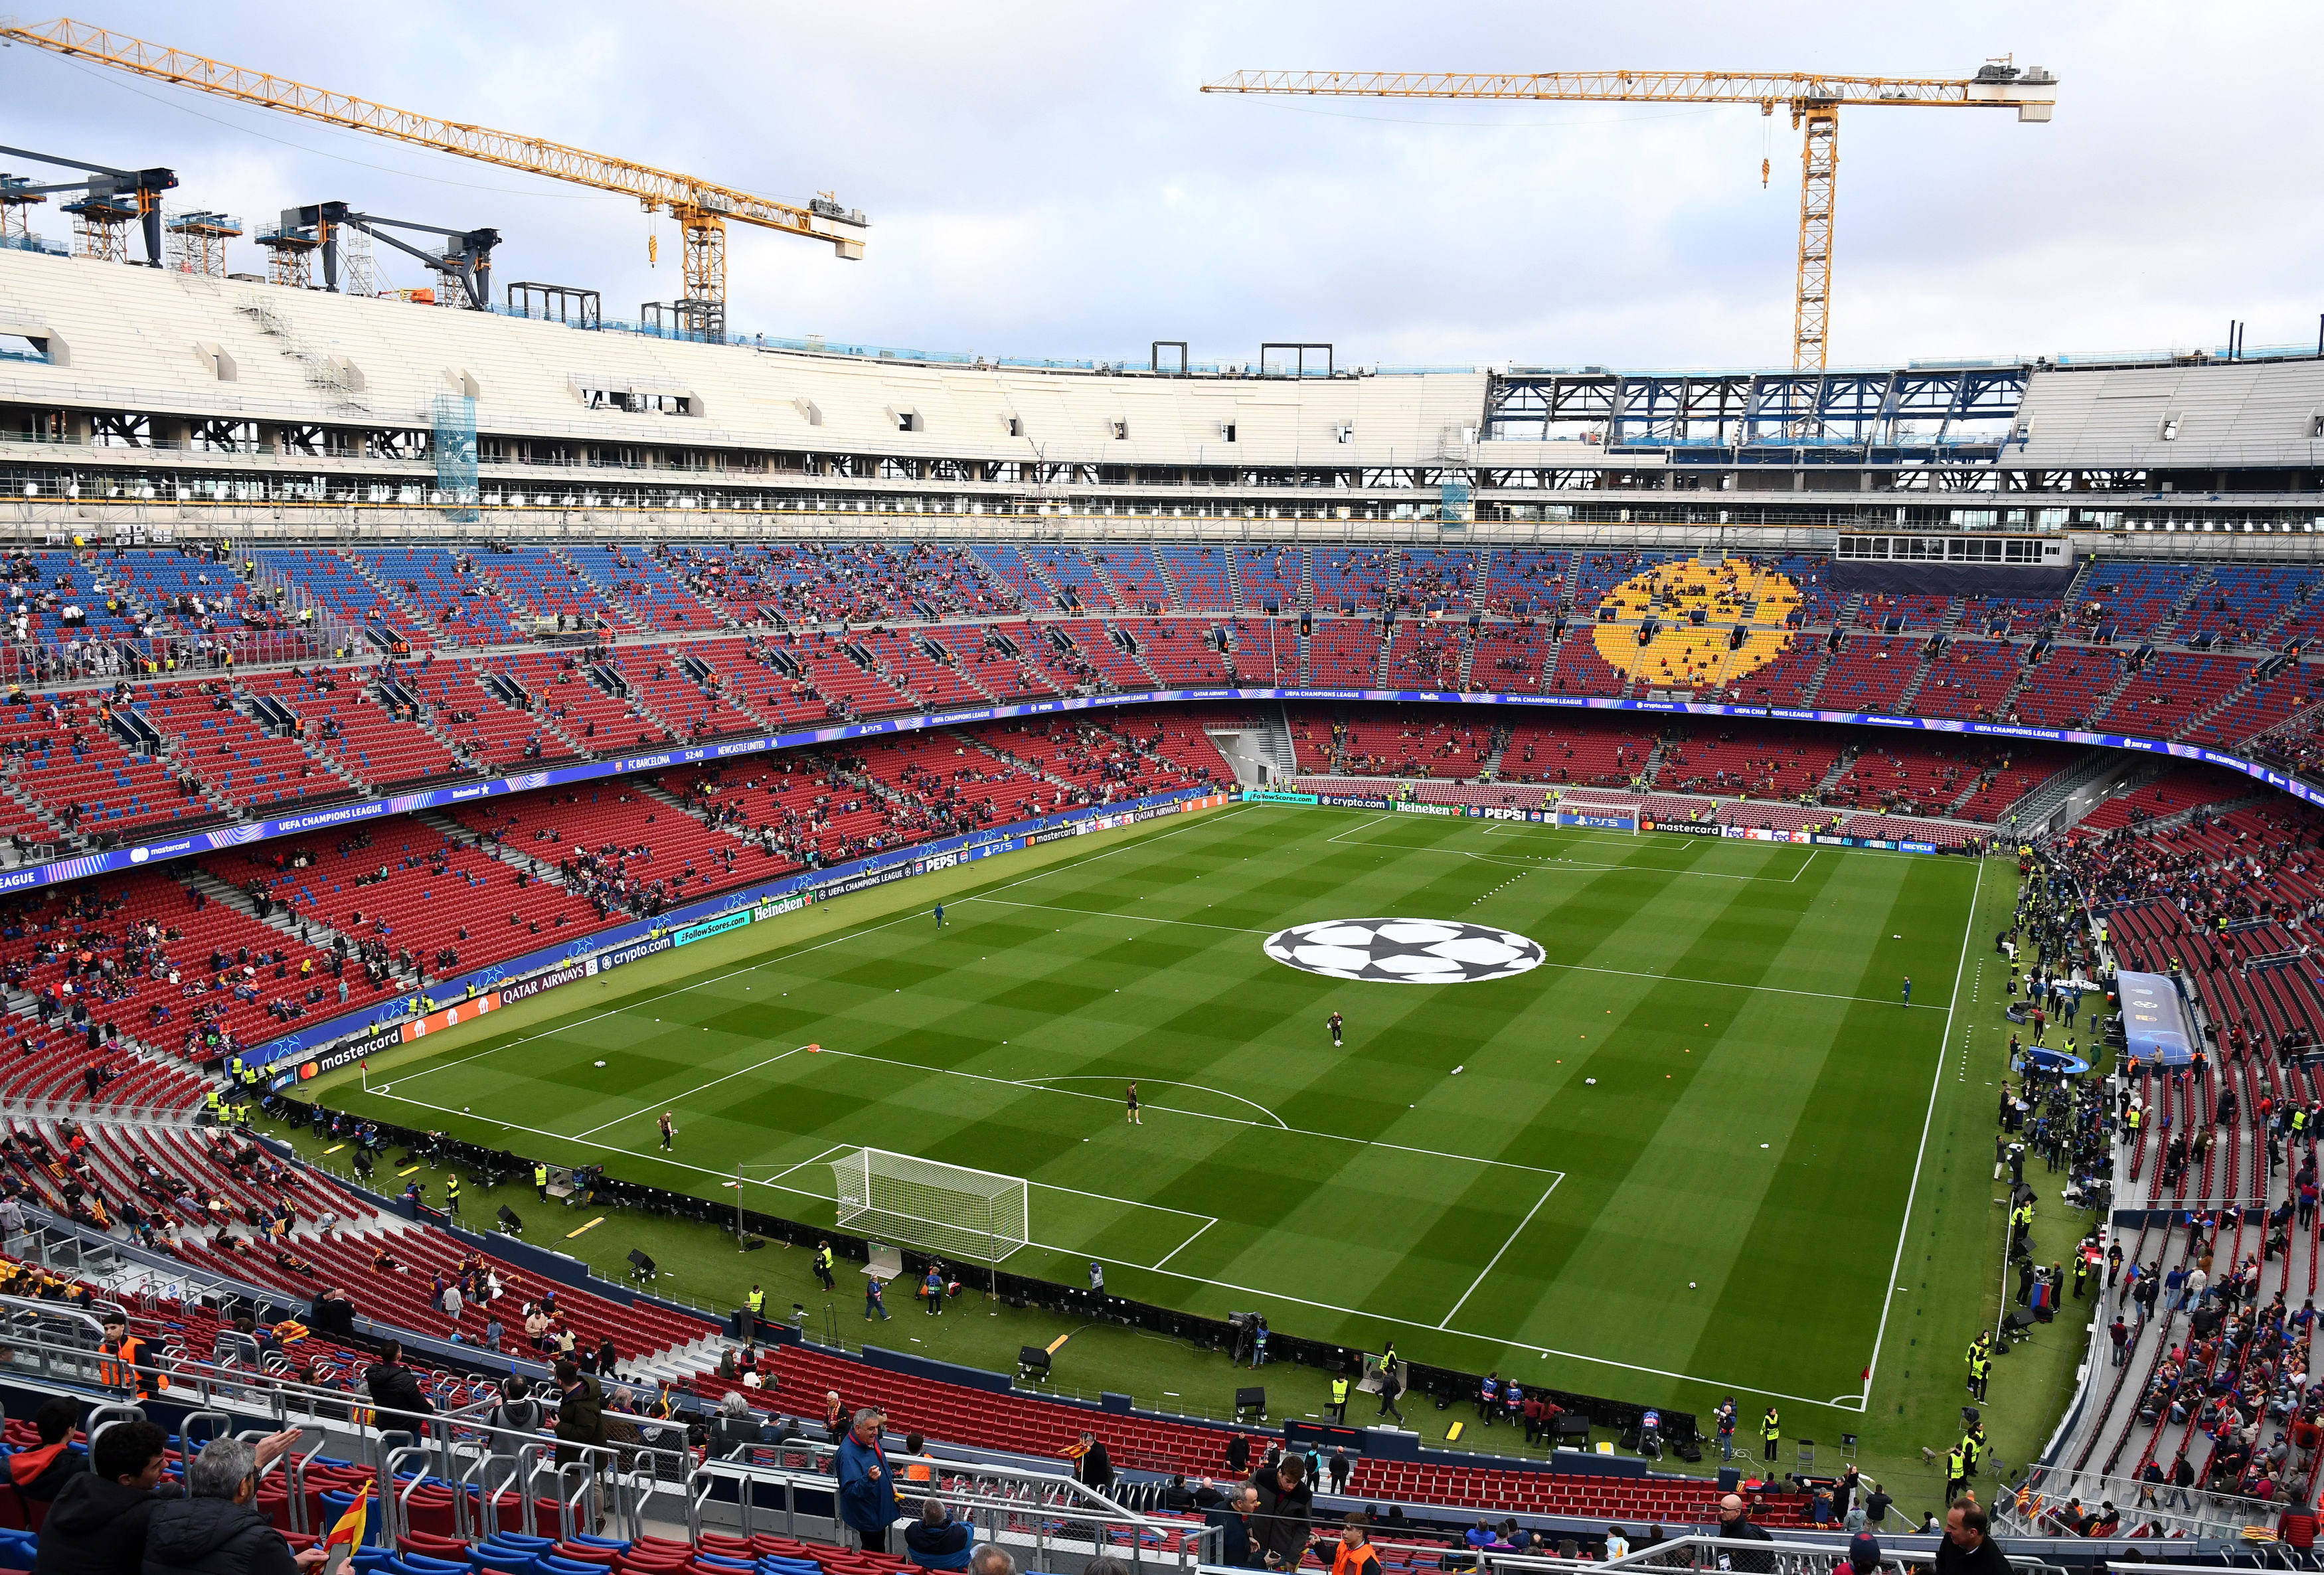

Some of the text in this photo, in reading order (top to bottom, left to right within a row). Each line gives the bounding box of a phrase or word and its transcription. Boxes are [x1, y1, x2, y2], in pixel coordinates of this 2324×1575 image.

[944, 712, 971, 722] CHAMPIONS
[1993, 726, 2032, 735] CHAMPIONS
[718, 740, 765, 755] NEWCASTLE UNITED
[628, 754, 670, 770] FC BARCELONA
[685, 750, 703, 760] 52:40
[1333, 797, 1384, 808] crypto.com
[1396, 801, 1450, 815] Heineken
[279, 804, 382, 831] UEFA CHAMPIONS LEAGUE
[1135, 805, 1180, 821] QATAR AIRWAYS
[1485, 807, 1527, 821] PEPSI
[1086, 819, 1105, 833] FedEx
[1112, 814, 1131, 827] FedEx
[1590, 817, 1618, 827] PS5
[1037, 826, 1075, 843] mastercard
[1657, 823, 1718, 834] mastercard
[1726, 827, 1758, 839] FedEx
[1772, 831, 1804, 843] FedEx
[1817, 836, 1853, 846] WELCOME ALL
[151, 841, 190, 855] mastercard
[993, 842, 1013, 853] PS5
[926, 854, 957, 872] PEPSI
[828, 870, 902, 896] UEFA CHAMPIONS LEAGUE
[754, 897, 803, 922] Heineken
[685, 916, 744, 940] FollowScores.com
[614, 938, 670, 964] crypto.com
[503, 965, 584, 1004] QATAR AIRWAYS
[321, 1030, 398, 1070] mastercard
